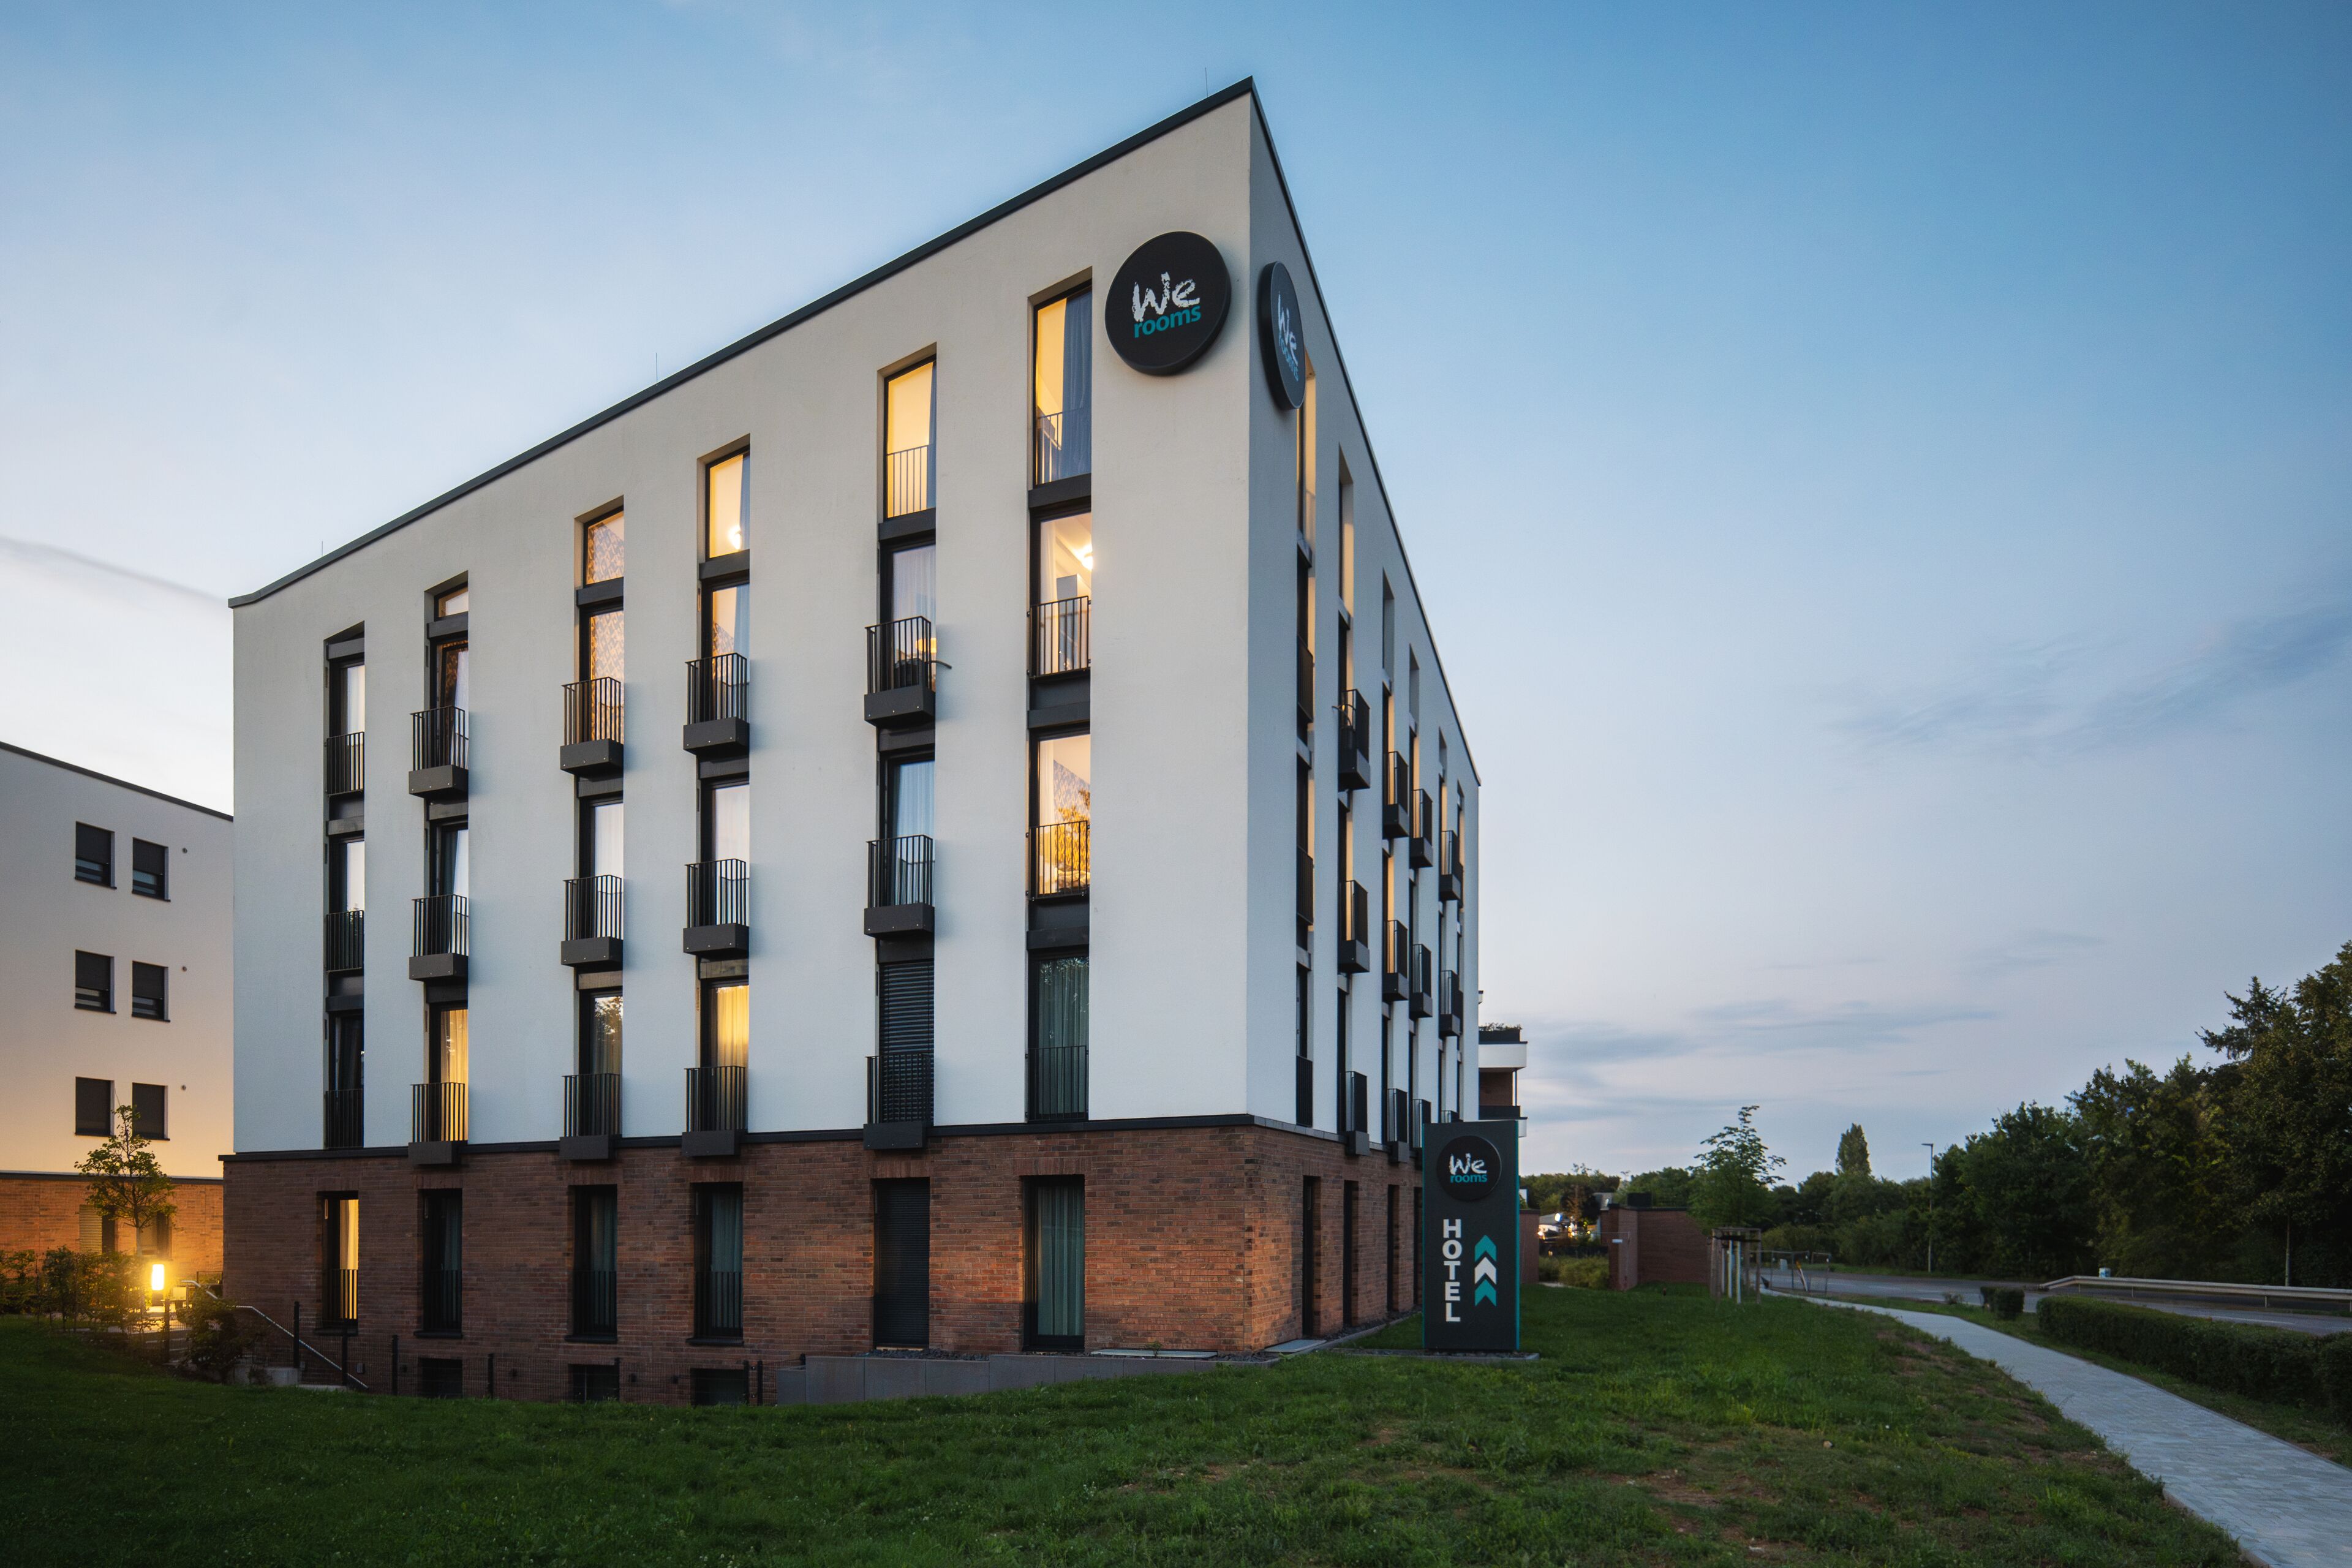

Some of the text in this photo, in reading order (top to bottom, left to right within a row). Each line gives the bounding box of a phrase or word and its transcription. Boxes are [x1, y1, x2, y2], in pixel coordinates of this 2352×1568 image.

[1132, 271, 1200, 322] We
[1134, 305, 1201, 338] rooms
[1278, 291, 1298, 366] We
[1449, 1153, 1487, 1174] We
[1450, 1173, 1487, 1183] rooms
[1442, 1219, 1462, 1322] HOTEL
